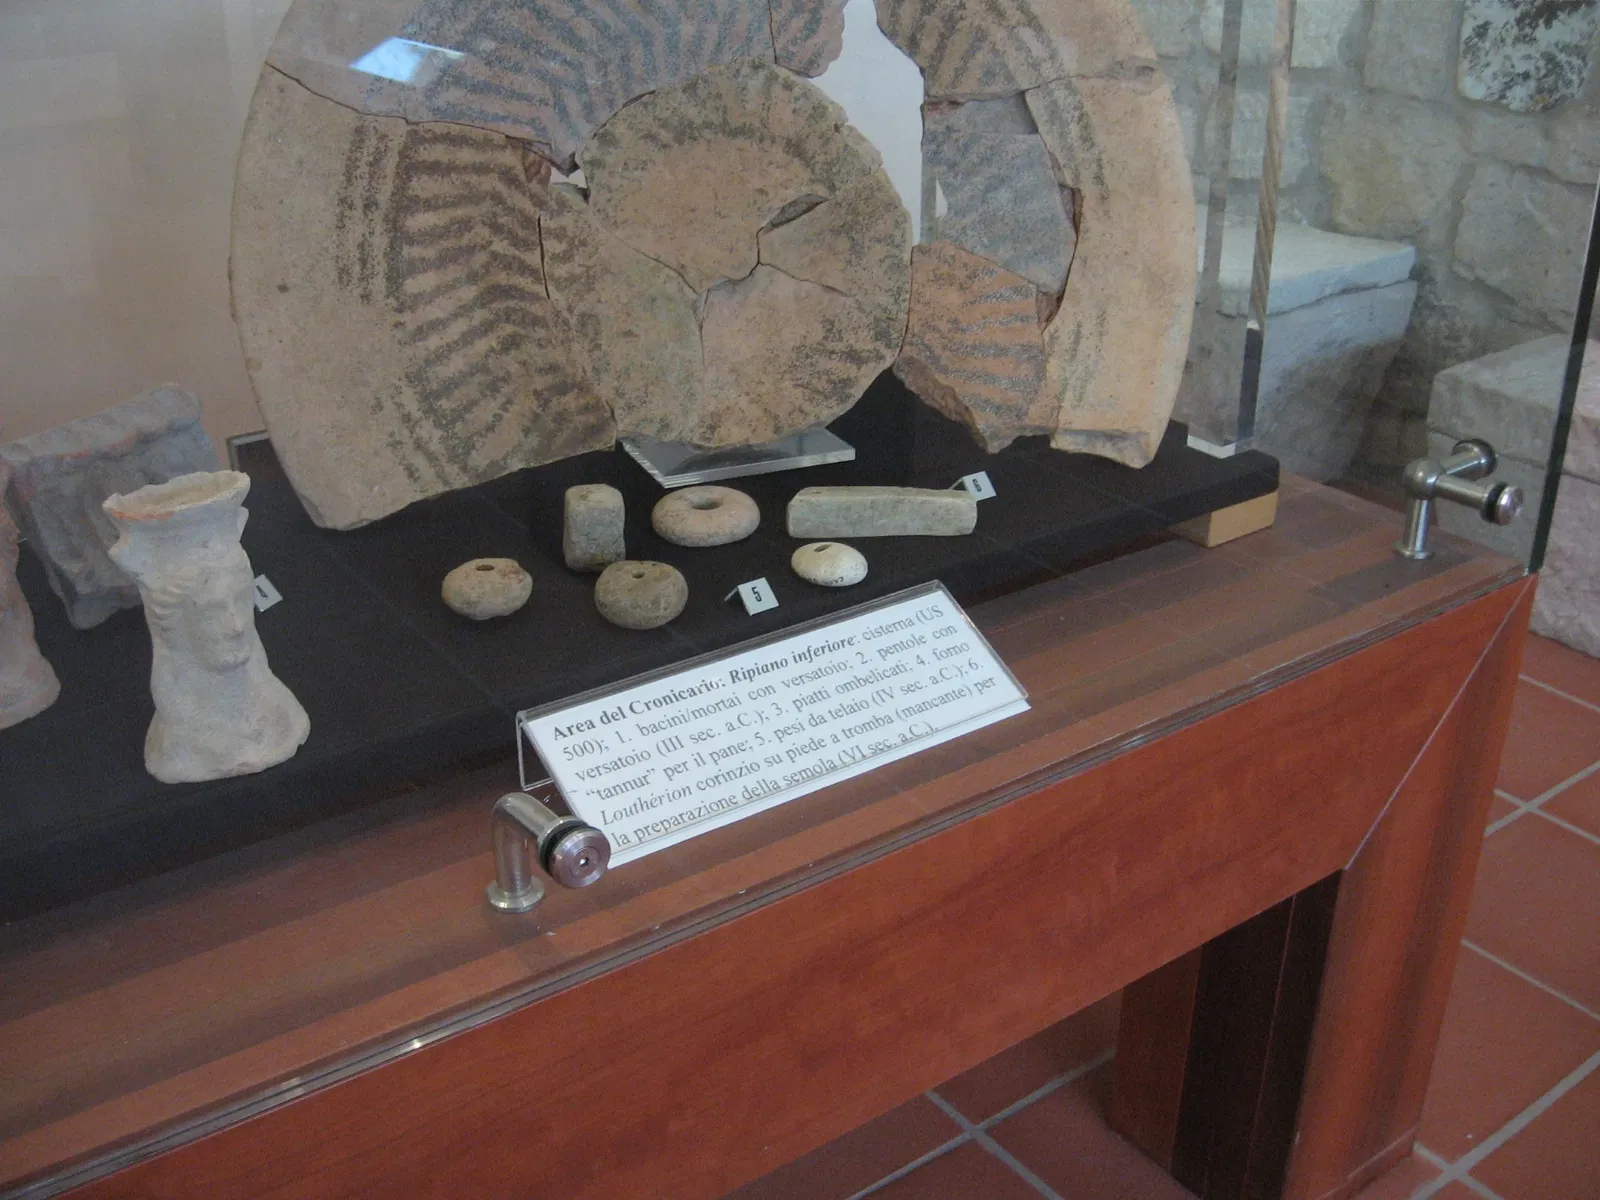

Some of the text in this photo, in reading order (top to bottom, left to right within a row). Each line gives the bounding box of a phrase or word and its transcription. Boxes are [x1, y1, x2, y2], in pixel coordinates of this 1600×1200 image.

[751, 586, 763, 602] 5
[554, 605, 943, 740] Area del Cronicario: Ripiano inferiore: cisterna (US
[563, 625, 957, 761] 500); 1. bacini/mortai con versatoio; 2. pentole con
[574, 748, 651, 780] versatoio
[655, 735, 684, 756] (III
[688, 728, 720, 744] sec.
[724, 710, 770, 732] a.C.);
[770, 702, 788, 716] 3.
[791, 685, 831, 712] piatti
[834, 659, 912, 694] ombelicati;
[916, 654, 930, 665] 4.
[662, 760, 689, 781] per
[690, 751, 706, 767] il
[708, 740, 752, 765] pane;
[754, 731, 771, 746] 5.
[772, 717, 805, 743] pesi
[808, 712, 827, 727] da
[827, 698, 869, 719] telaio
[871, 686, 894, 705] (IV
[899, 680, 927, 695] sec.
[928, 665, 968, 684] a.C.);
[968, 658, 983, 670] 6.
[600, 676, 996, 825] Louthérion corinzio su piede a tromba (mancante) per
[610, 723, 941, 847] la preparazione della semola (VI sec. a.C.).
